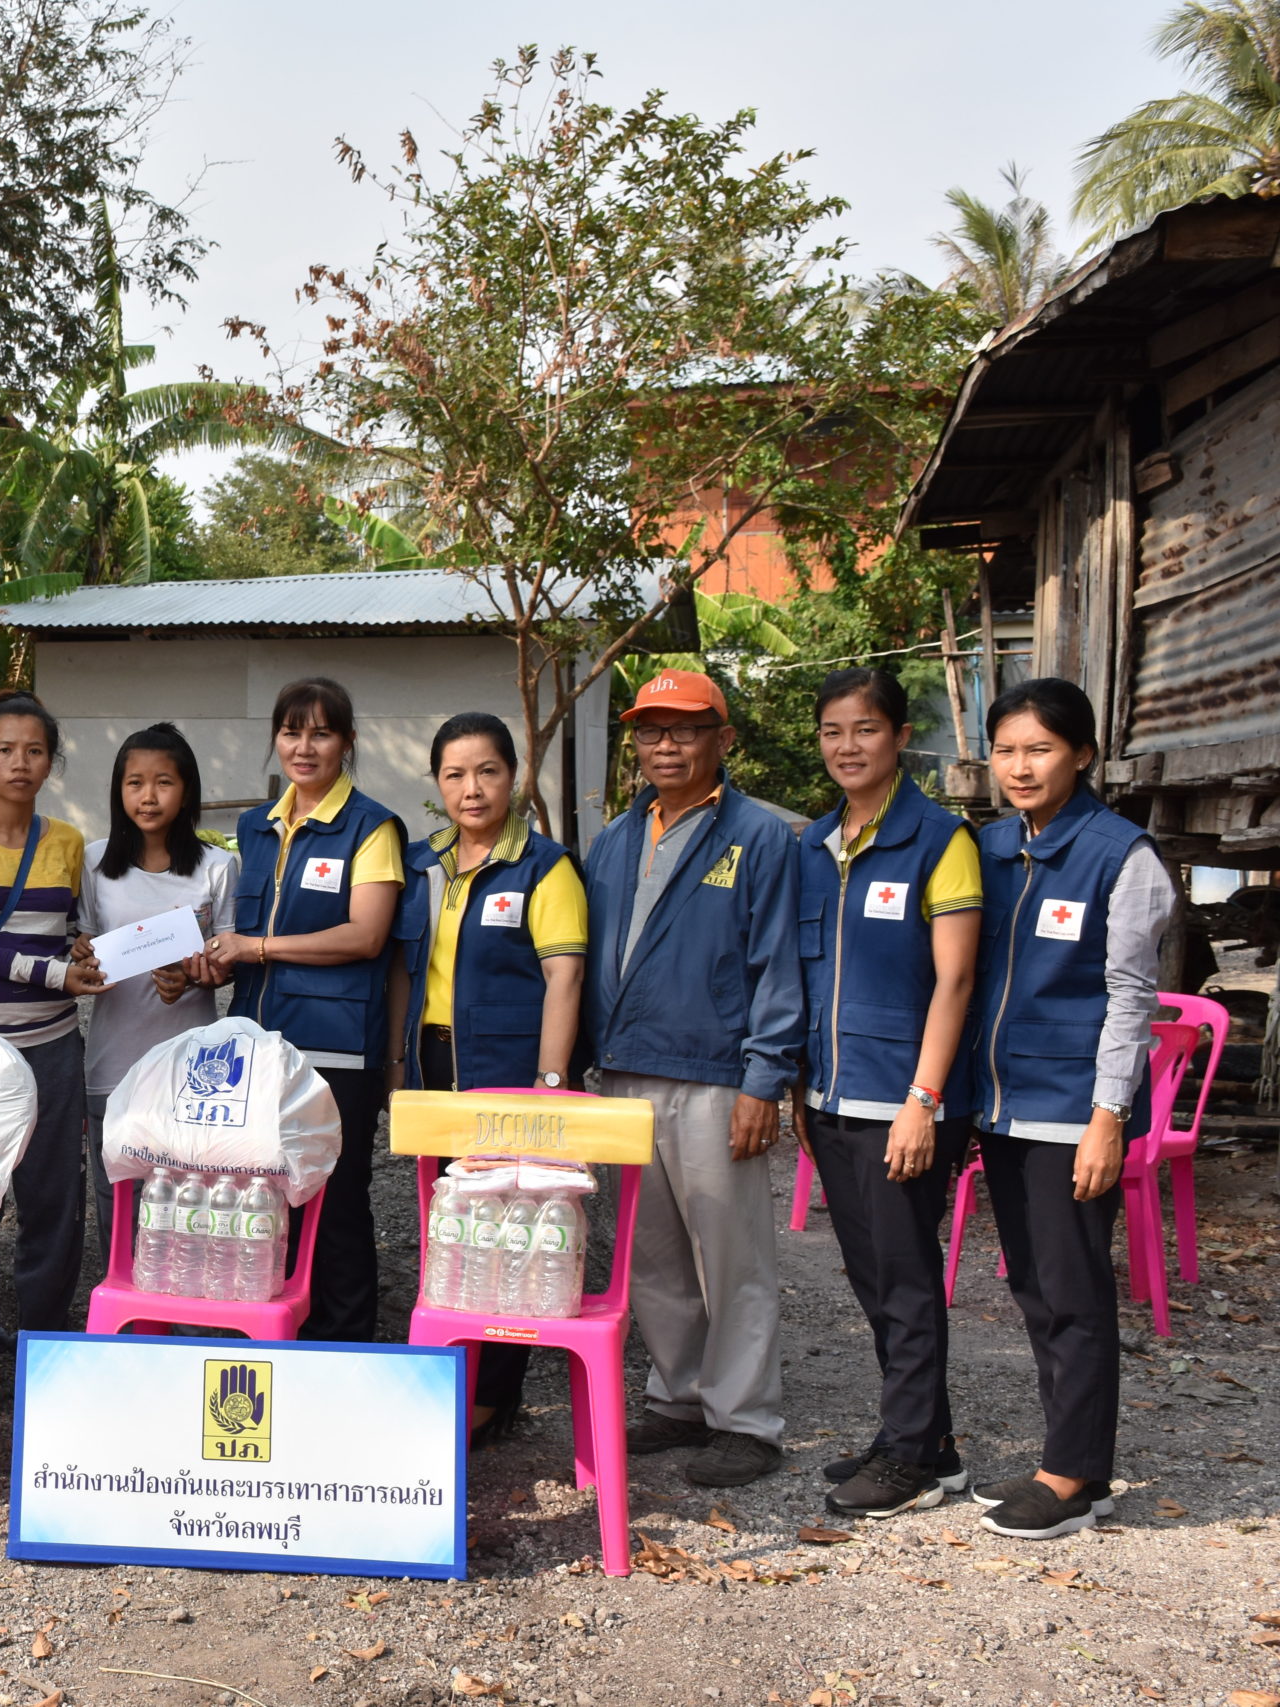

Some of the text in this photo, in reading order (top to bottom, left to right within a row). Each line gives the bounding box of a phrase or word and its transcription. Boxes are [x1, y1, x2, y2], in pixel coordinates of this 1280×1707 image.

[475, 1112, 567, 1148] DECEMBER
[215, 1438, 264, 1459] ปภ.
[33, 1462, 444, 1507] สำนักงานป้องกันและบรรเทาสาธารณภัย
[169, 1509, 303, 1550] จังหวัดลพบุรี
